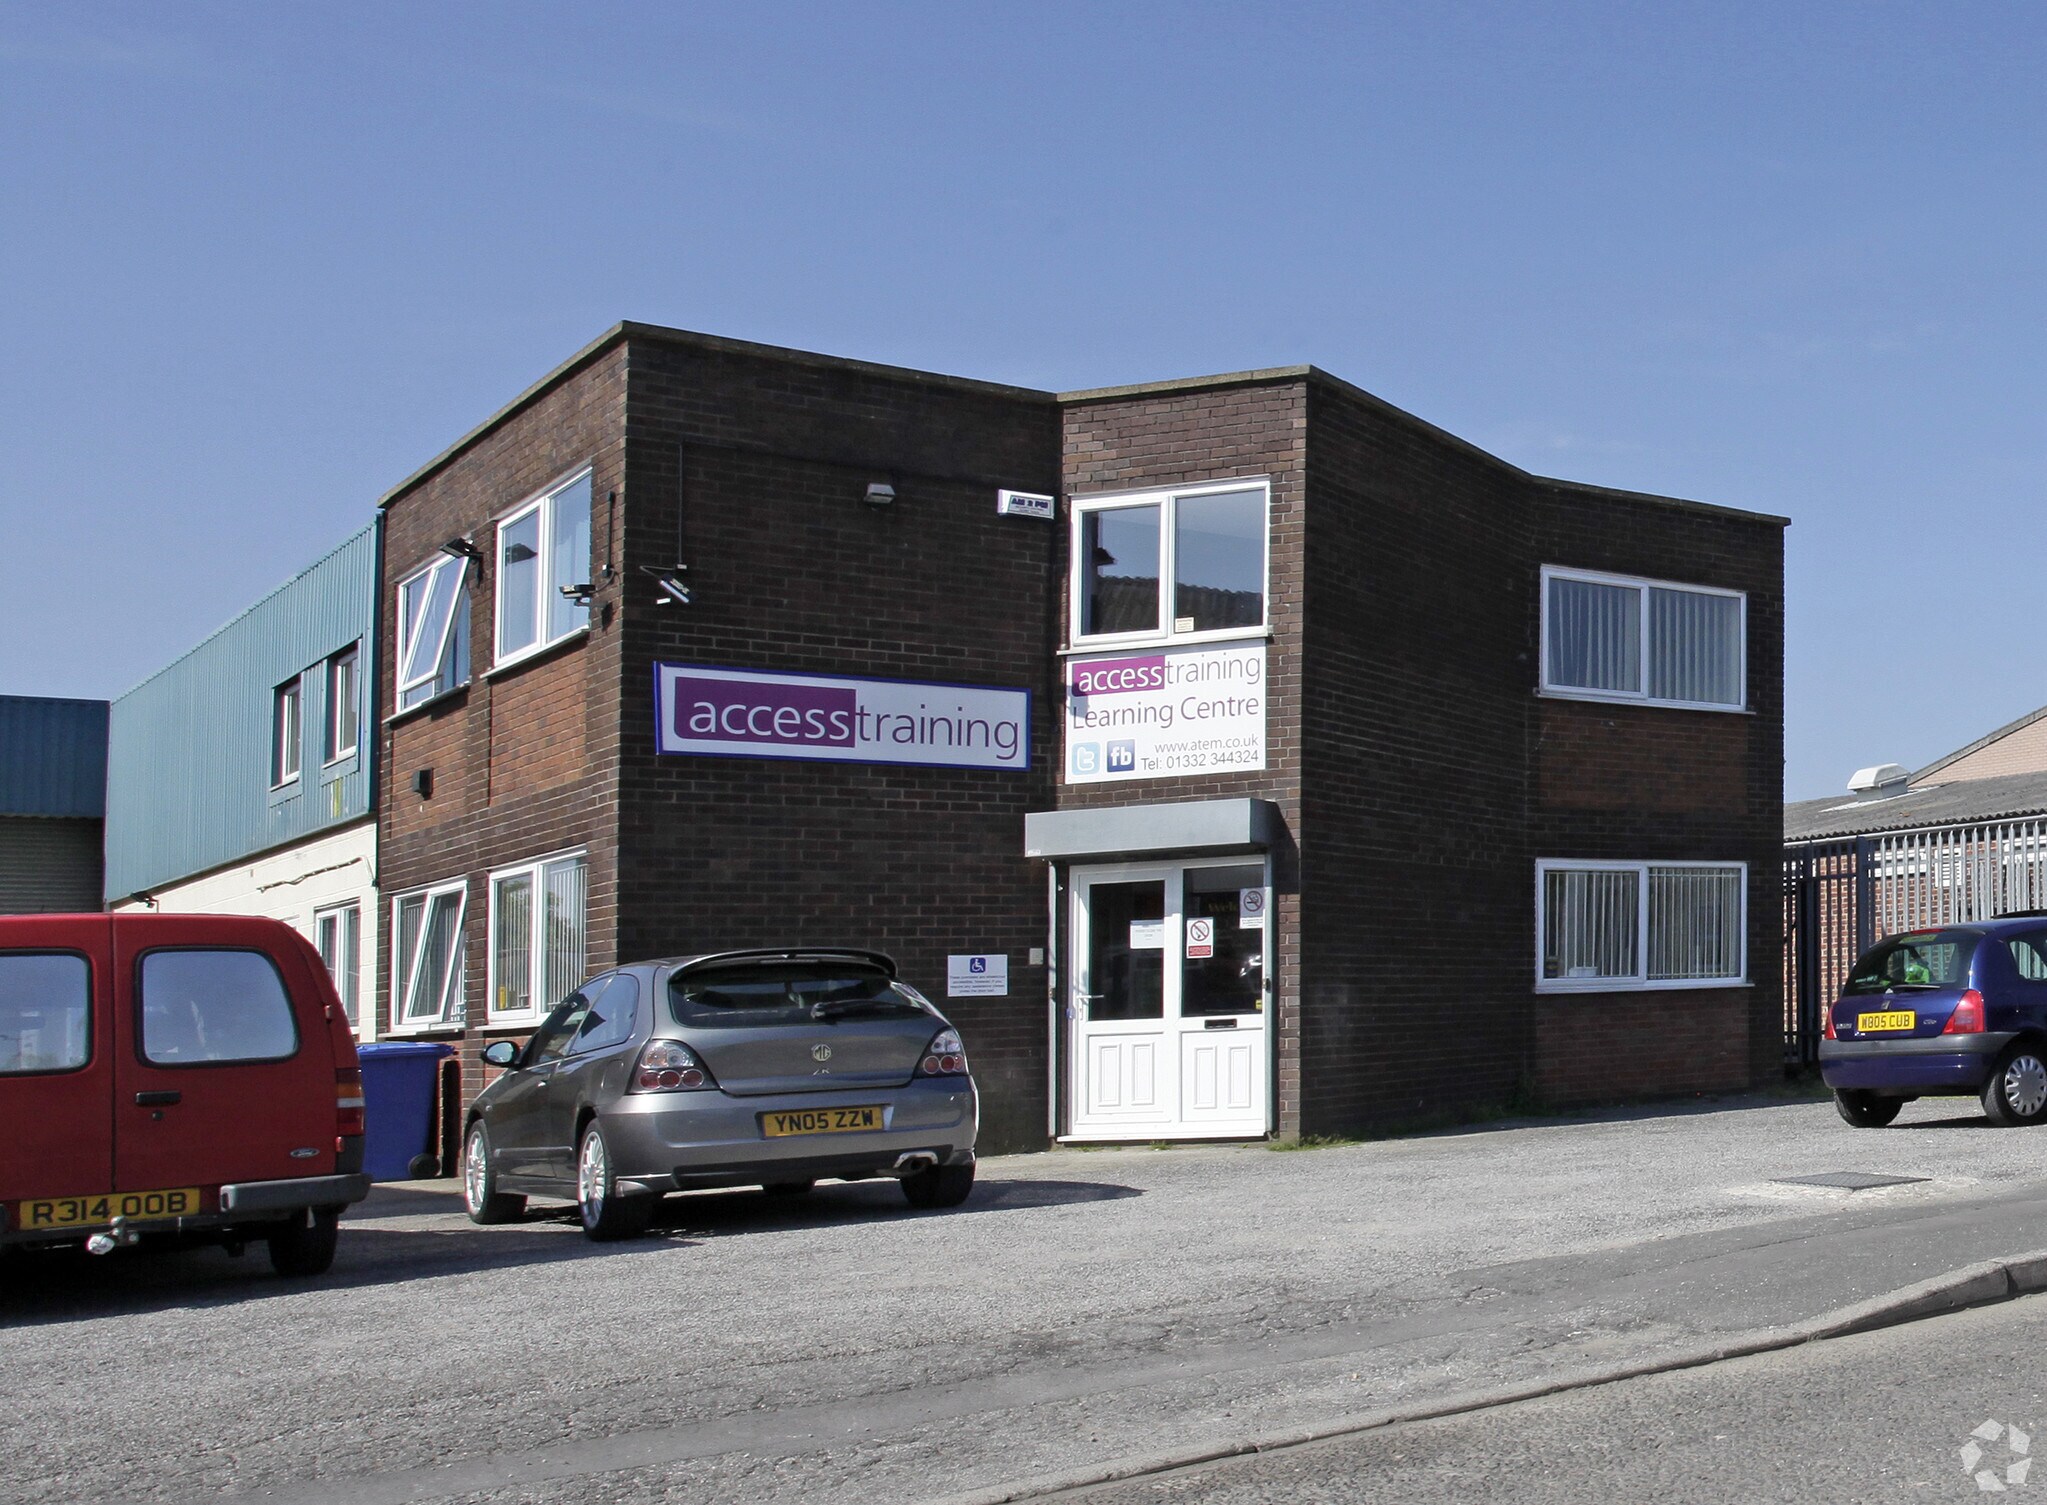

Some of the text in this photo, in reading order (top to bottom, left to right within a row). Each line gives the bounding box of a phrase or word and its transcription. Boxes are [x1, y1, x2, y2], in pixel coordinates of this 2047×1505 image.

[1073, 696, 1259, 728] Learning Centre
[1154, 733, 1259, 753] www.atem.co.uk
[1110, 745, 1132, 767] fb
[1140, 749, 1259, 771] Tel: 01332 344324
[1889, 1014, 1911, 1027] CUB
[813, 1044, 832, 1061] MG
[774, 1109, 874, 1132] YN05 ZZW
[31, 1198, 111, 1225] R314
